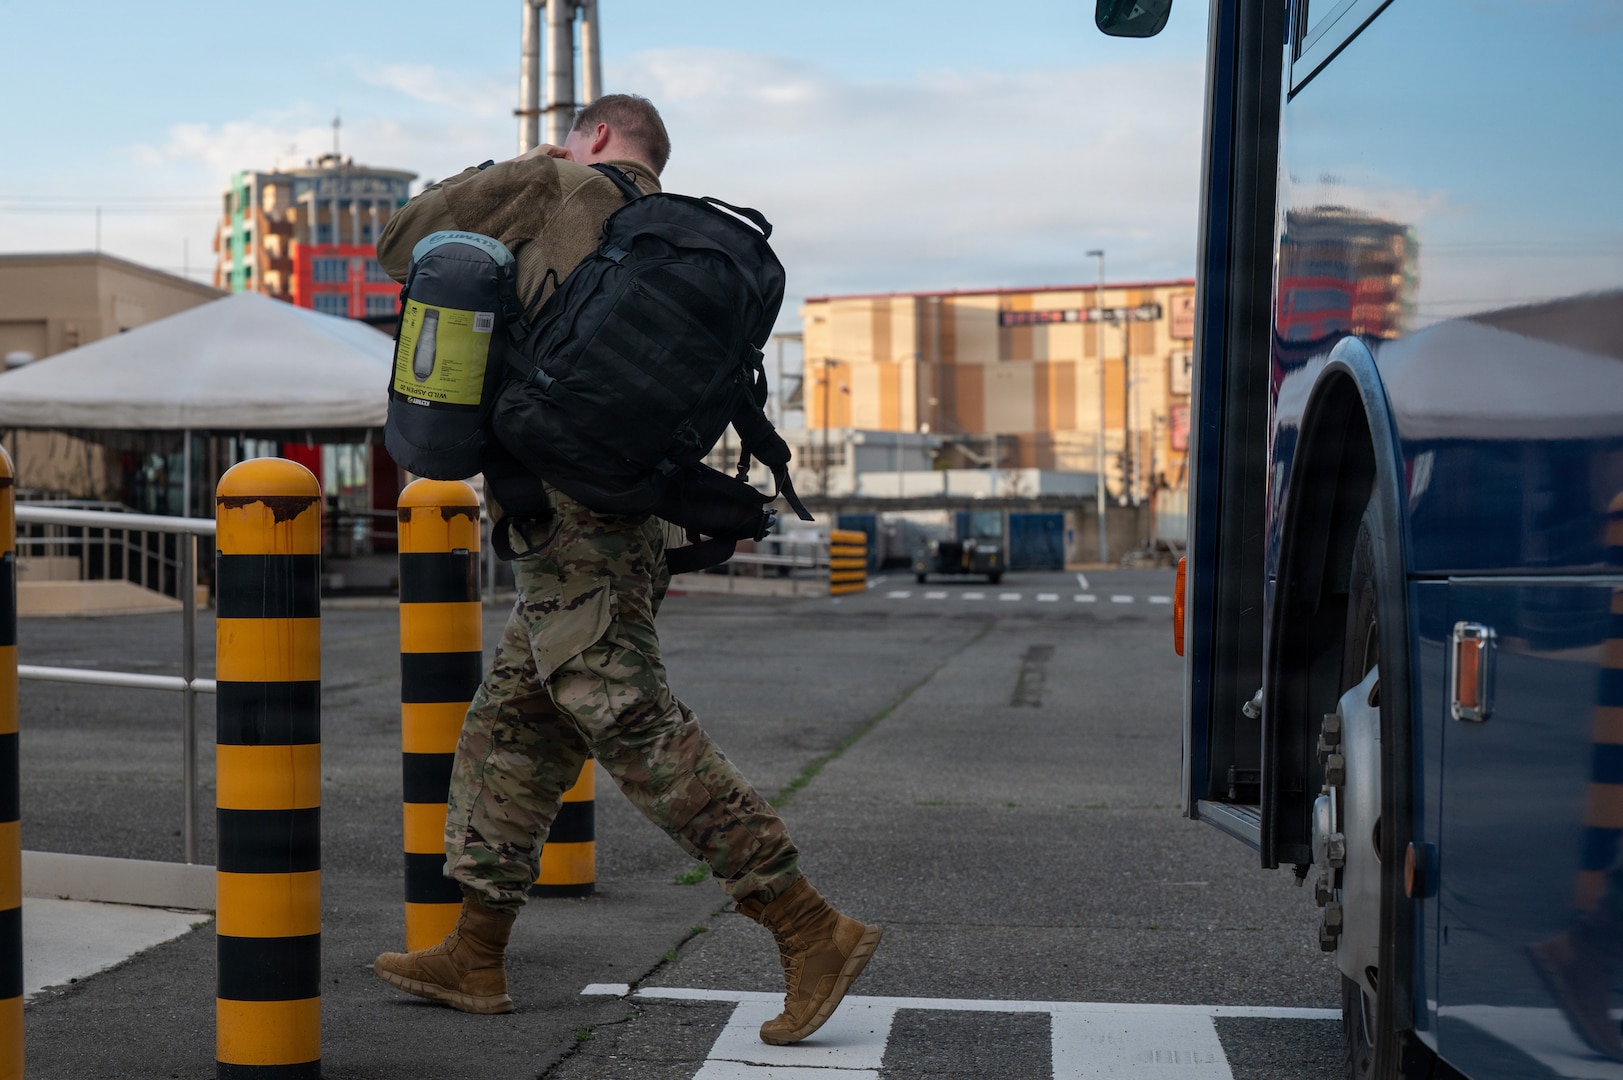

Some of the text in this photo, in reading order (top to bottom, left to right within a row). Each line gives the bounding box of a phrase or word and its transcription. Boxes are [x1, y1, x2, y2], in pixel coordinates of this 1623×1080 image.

[447, 234, 497, 249] KLYMIT
[406, 386, 427, 396] ASPEN
[428, 391, 447, 399] WILD
